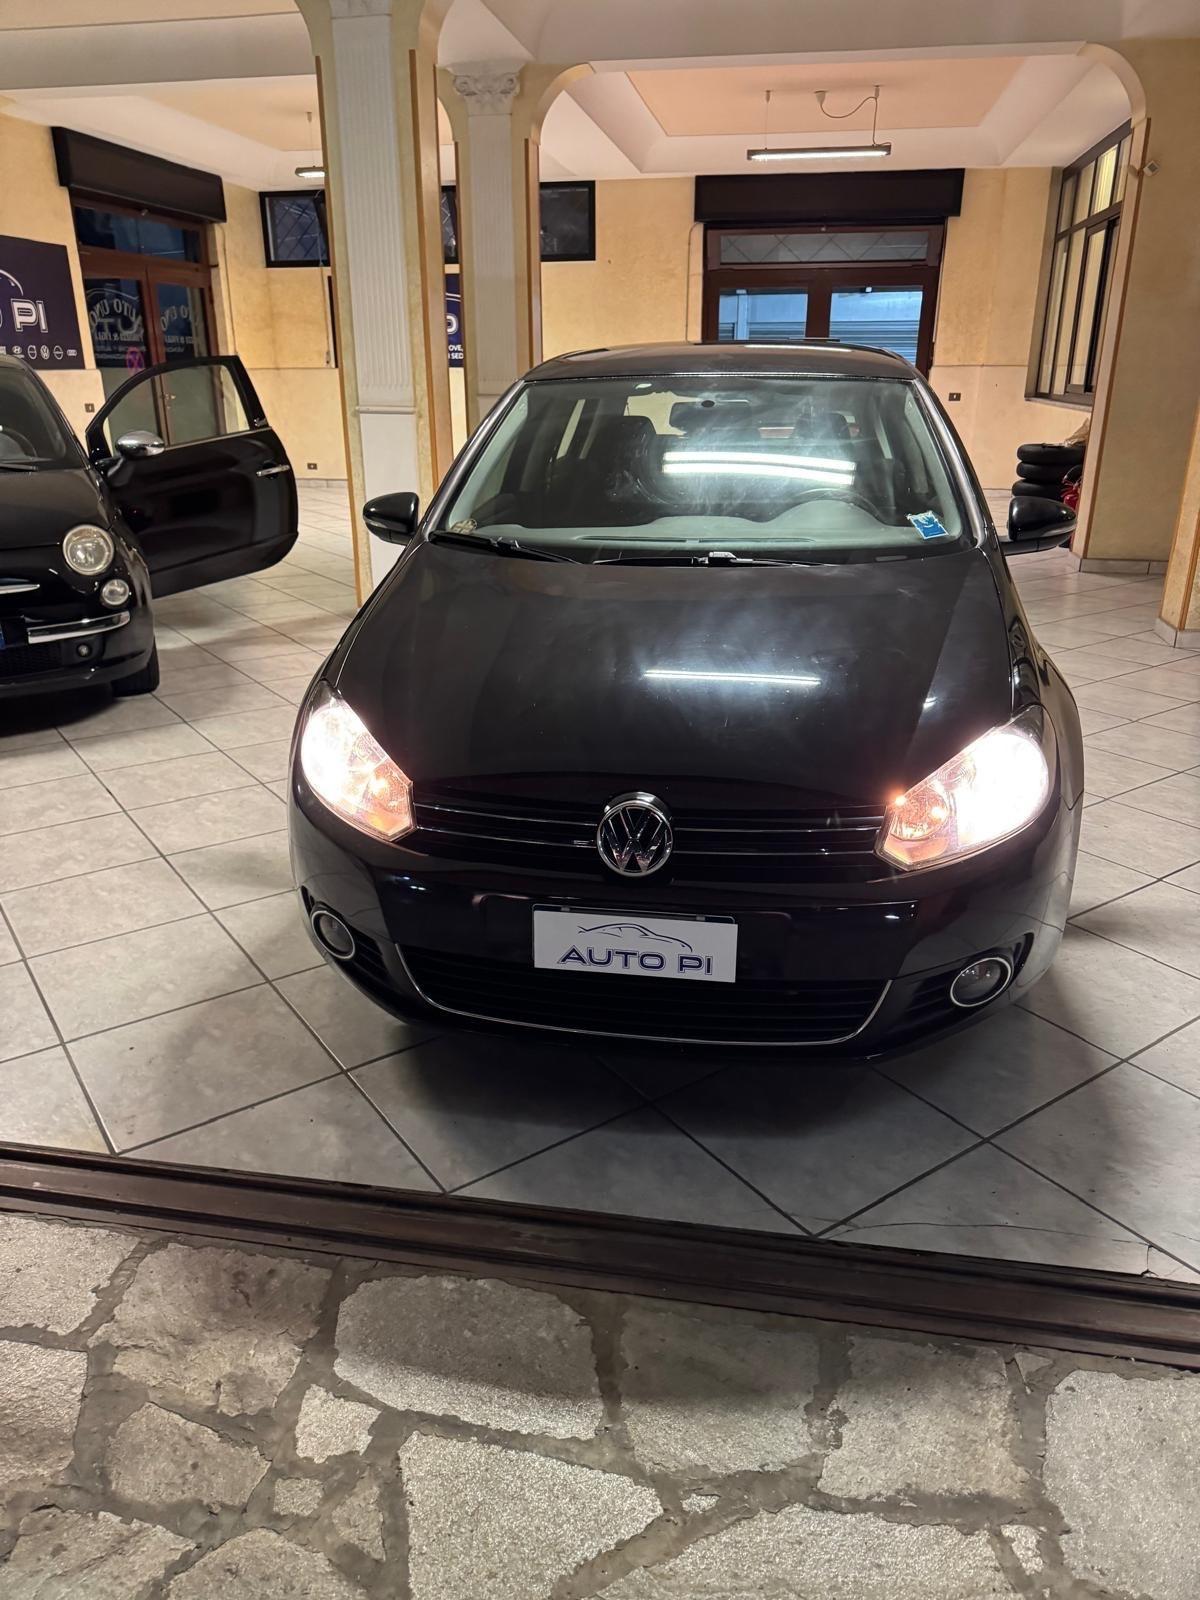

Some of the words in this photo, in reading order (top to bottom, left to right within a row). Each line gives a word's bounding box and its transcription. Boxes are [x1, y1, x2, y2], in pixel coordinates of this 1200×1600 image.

[11, 298, 48, 333] PI
[557, 944, 665, 970] AUTO
[677, 954, 713, 975] PI
